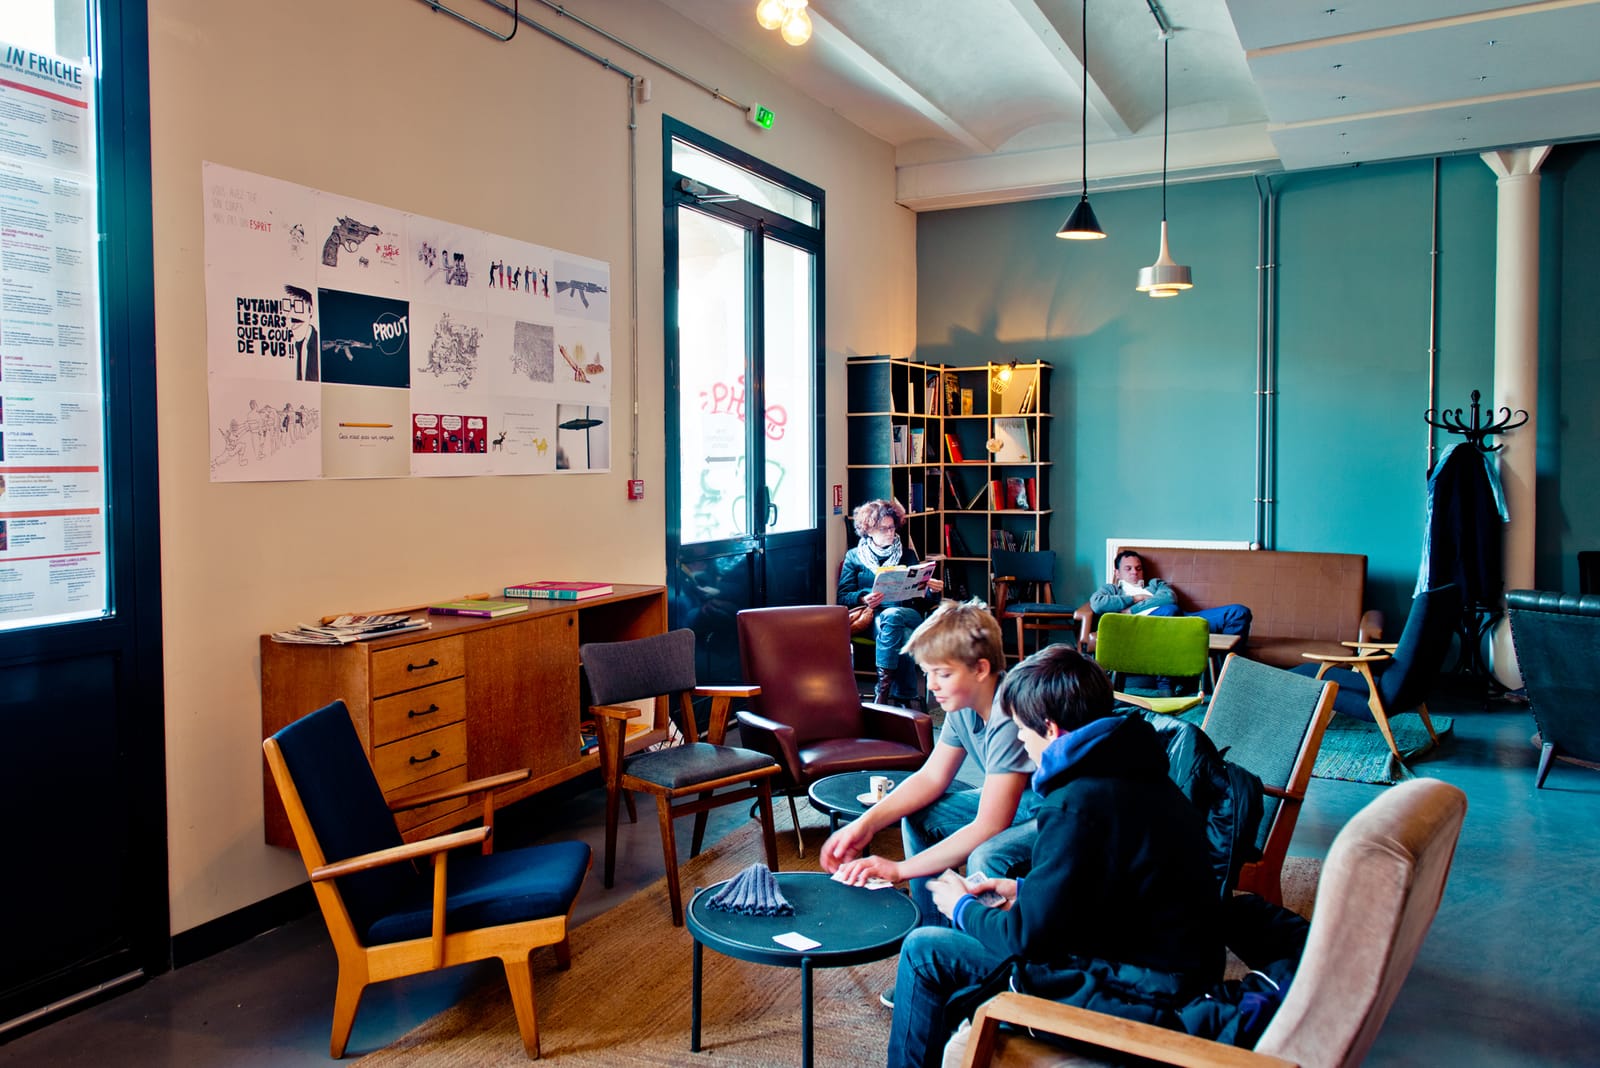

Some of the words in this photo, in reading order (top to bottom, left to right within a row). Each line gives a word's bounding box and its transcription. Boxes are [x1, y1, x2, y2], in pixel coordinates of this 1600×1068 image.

[6, 46, 25, 66] IN
[29, 52, 82, 84] FRICHE
[249, 219, 272, 233] ESPRIT
[237, 311, 259, 326] LES
[260, 314, 287, 328] GARS
[372, 315, 409, 341] PROUT
[237, 326, 267, 341] QUEL
[267, 328, 294, 343] COUP
[237, 339, 255, 354] DE
[260, 340, 287, 357] PUB
